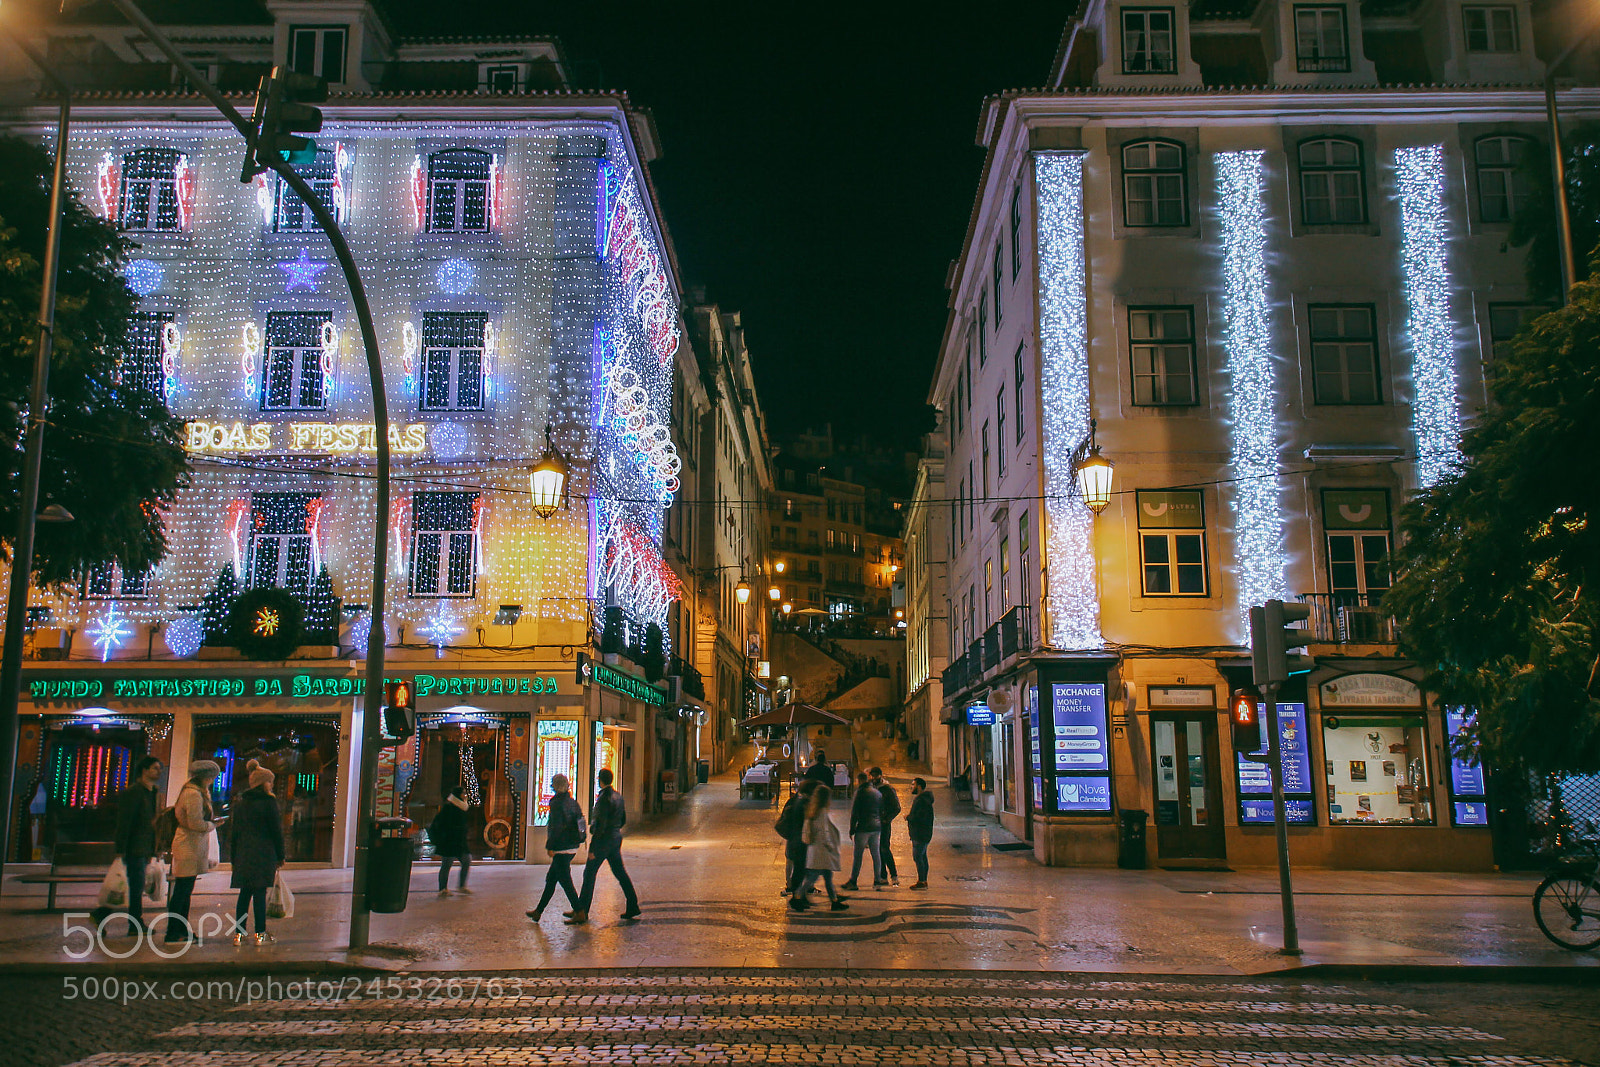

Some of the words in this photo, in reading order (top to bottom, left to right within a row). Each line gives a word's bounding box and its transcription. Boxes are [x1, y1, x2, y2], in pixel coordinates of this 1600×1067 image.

[185, 422, 271, 450] BOAS
[290, 423, 426, 451] FESTAS
[30, 680, 103, 697] MUNDO
[255, 679, 283, 695] DA
[415, 674, 558, 697] PORTUGUESA
[1056, 688, 1101, 697] EXCHANGE
[1340, 695, 1372, 704] LIVRARIA
[1374, 695, 1406, 704] TABACOS
[1067, 741, 1097, 749] MoneyGram
[1079, 784, 1106, 794] Nova
[1080, 795, 1107, 803] Câmbios
